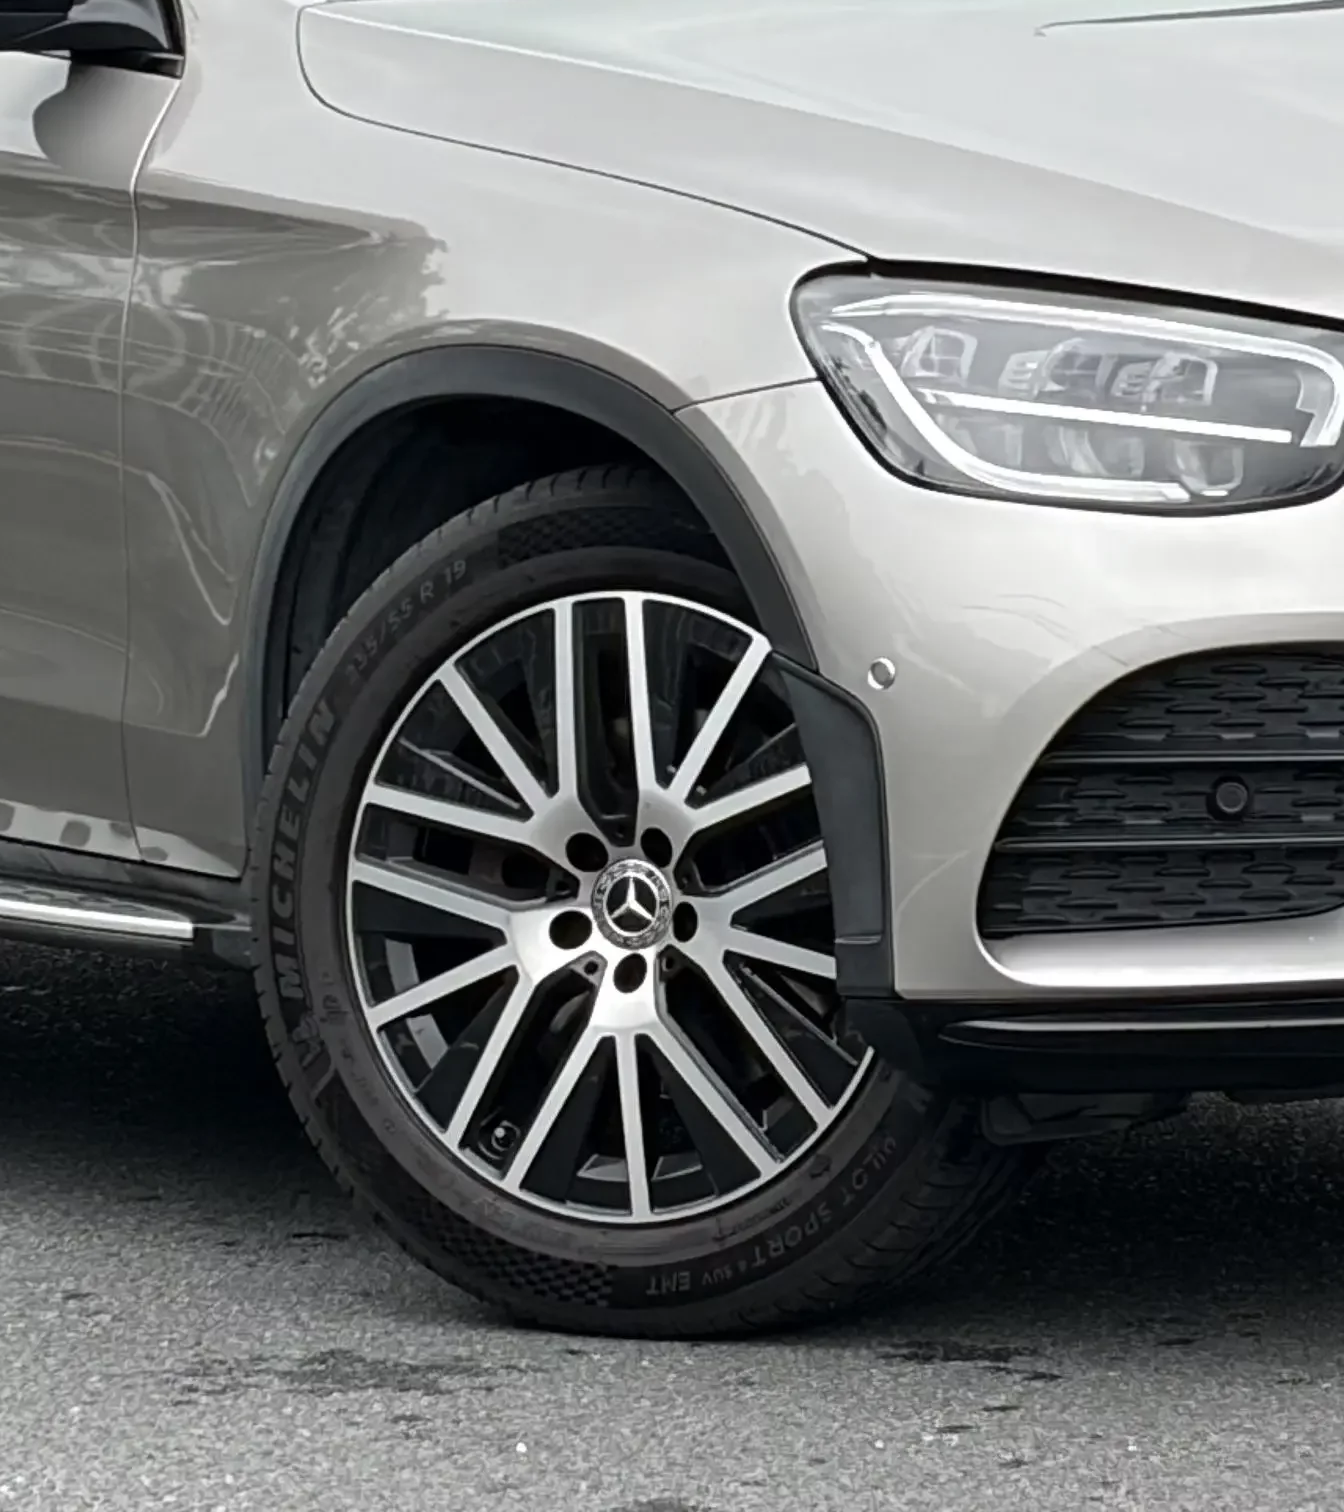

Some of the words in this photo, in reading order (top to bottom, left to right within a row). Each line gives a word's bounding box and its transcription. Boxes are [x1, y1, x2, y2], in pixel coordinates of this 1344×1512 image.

[420, 580, 435, 604] R
[444, 559, 466, 584] 19
[272, 699, 336, 1000] MICHELIN
[750, 1201, 832, 1268] SPORT
